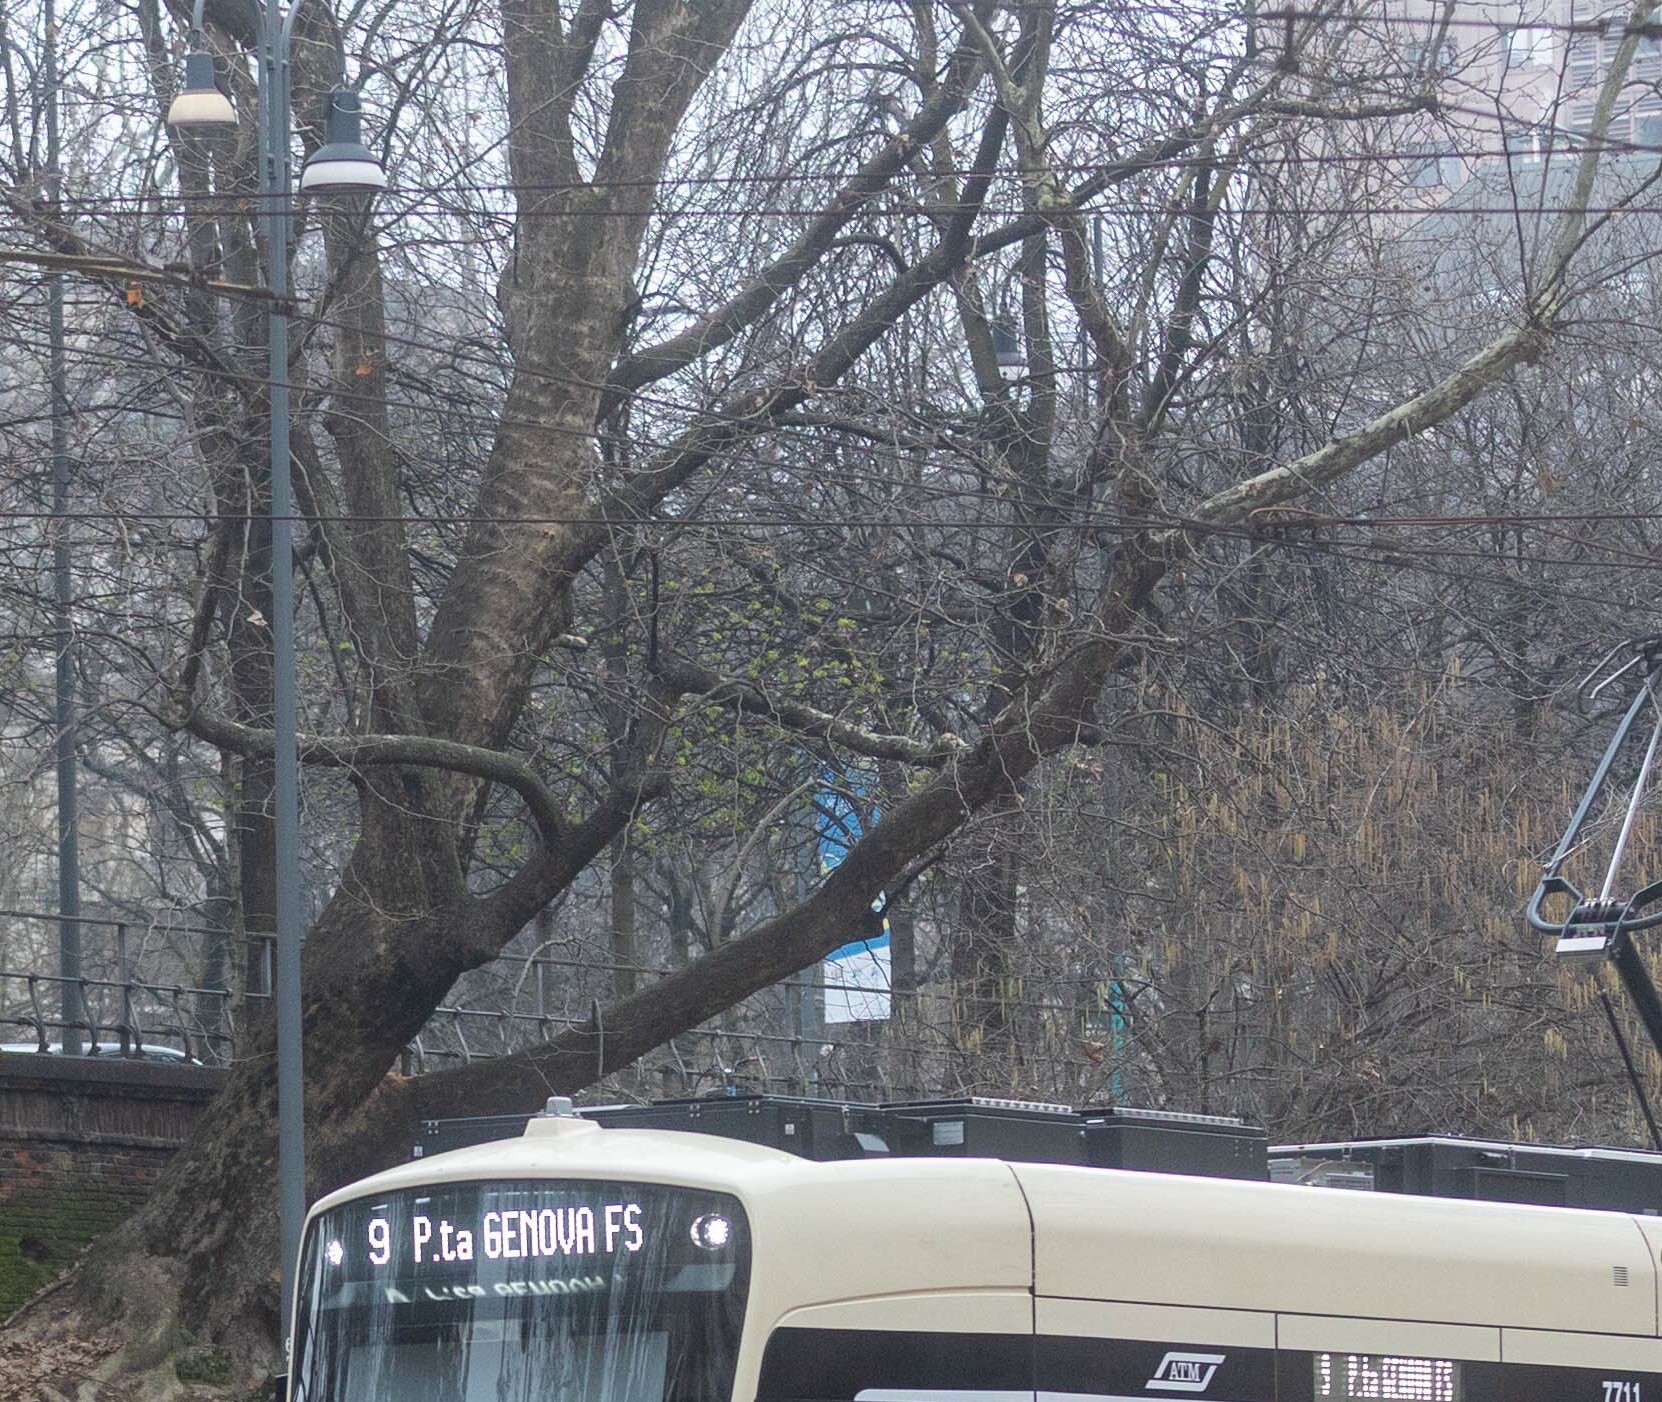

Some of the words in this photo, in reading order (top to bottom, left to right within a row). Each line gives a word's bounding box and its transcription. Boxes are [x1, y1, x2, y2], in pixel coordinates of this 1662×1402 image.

[368, 1218, 390, 1265] 9
[413, 1216, 473, 1263] P.ta
[483, 1206, 595, 1259] GENOVA
[605, 1203, 644, 1253] FS
[1168, 1361, 1200, 1381] ATM
